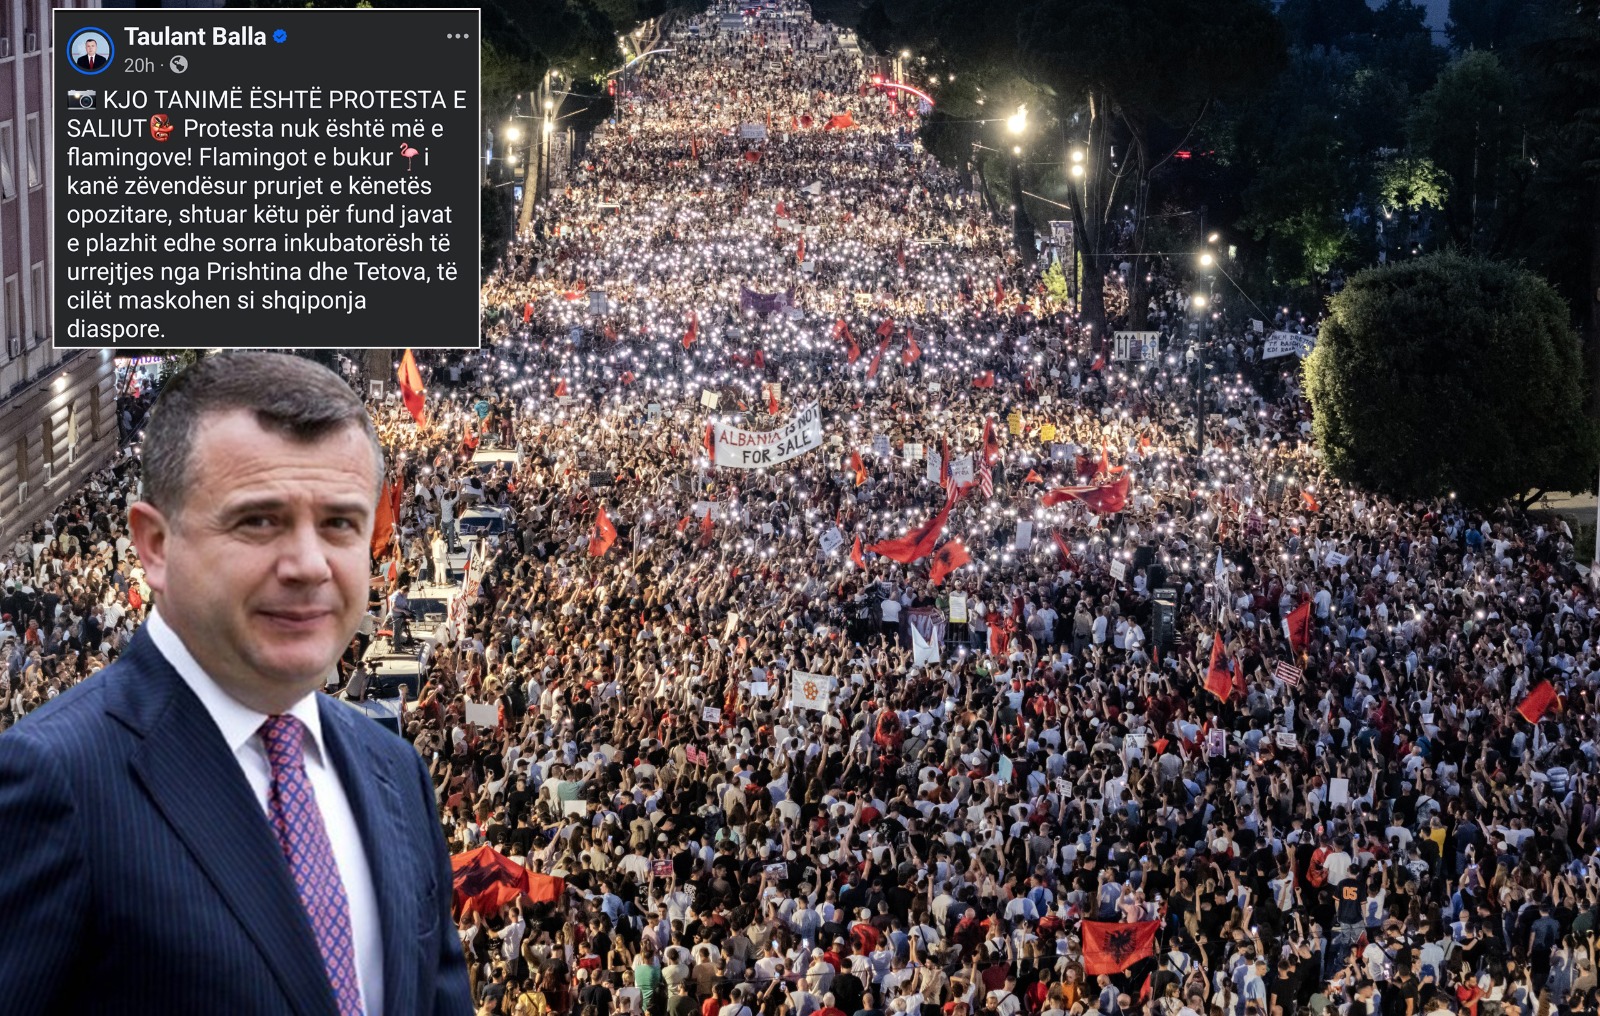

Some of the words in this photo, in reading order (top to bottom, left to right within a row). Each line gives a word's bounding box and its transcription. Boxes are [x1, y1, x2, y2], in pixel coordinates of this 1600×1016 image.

[718, 429, 782, 447] ALBANIA
[785, 423, 796, 438] IS
[798, 402, 819, 429] NOT
[742, 449, 771, 464] FOR
[776, 430, 812, 457] SALE
[1343, 887, 1357, 900] 05
